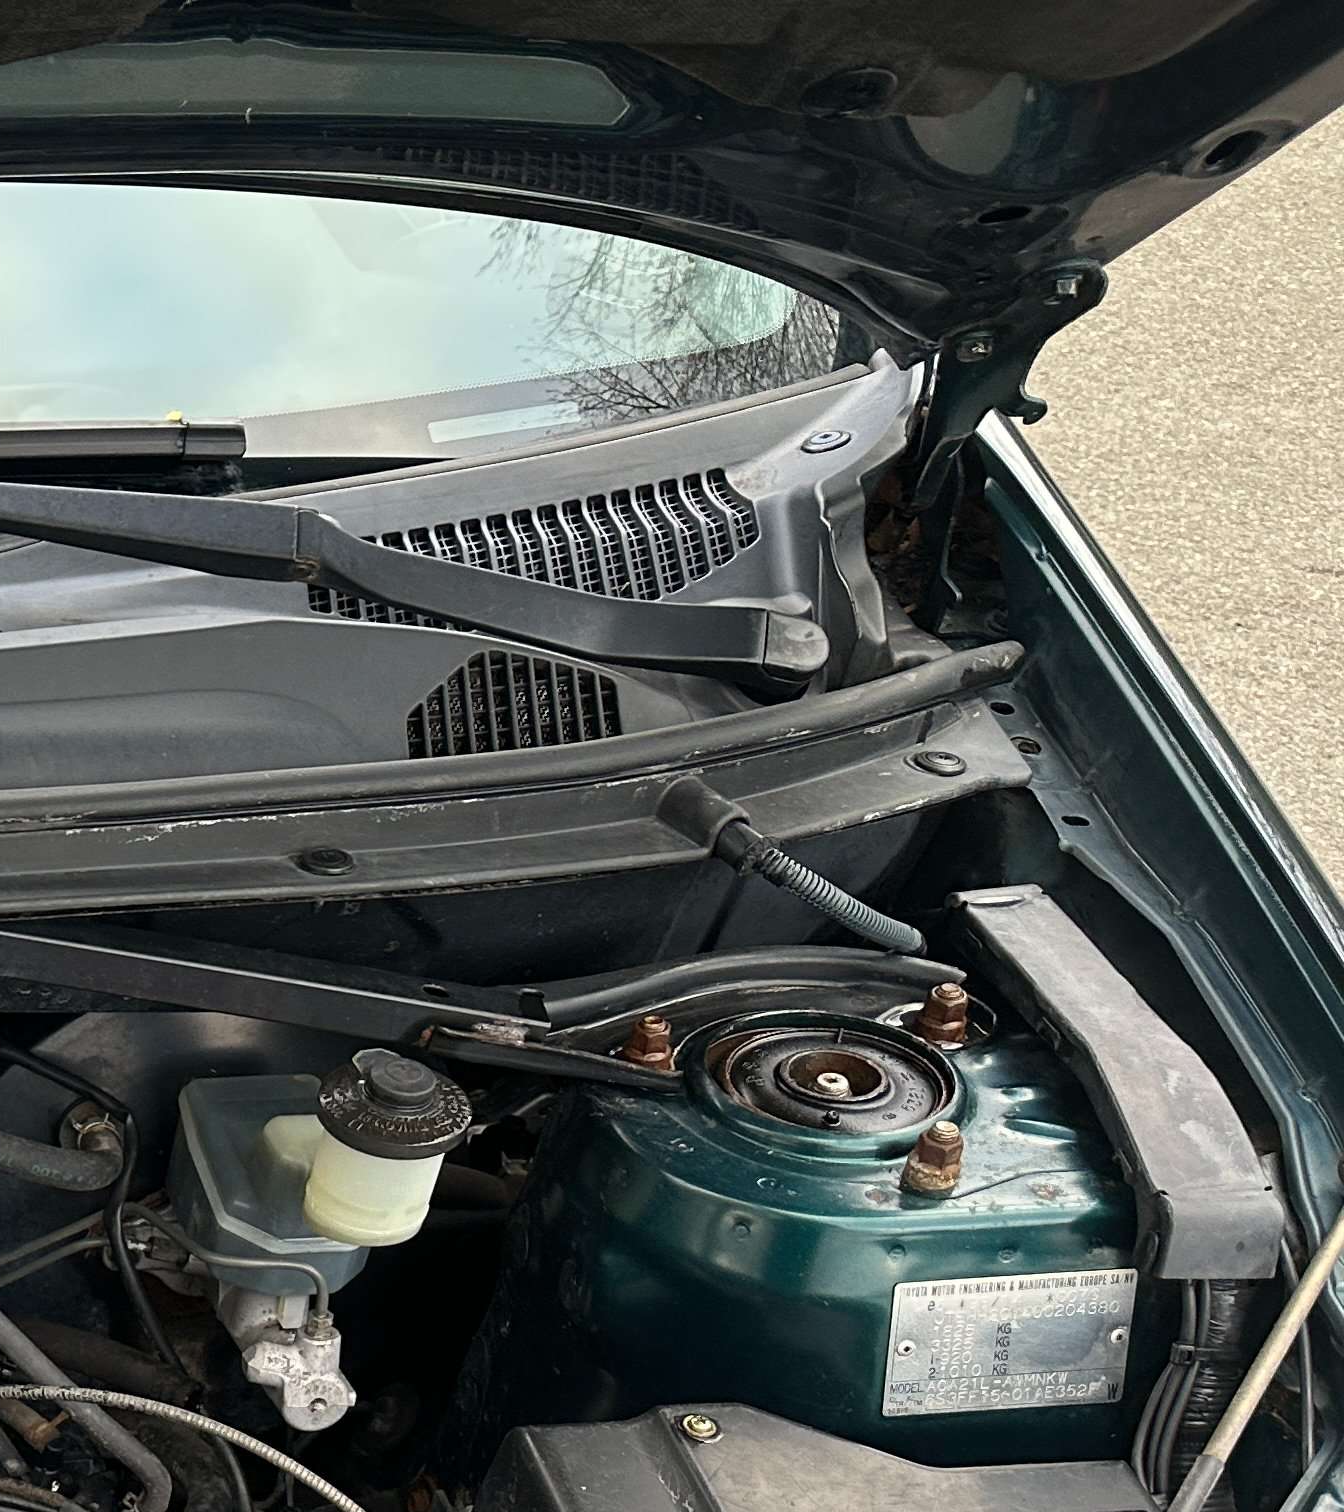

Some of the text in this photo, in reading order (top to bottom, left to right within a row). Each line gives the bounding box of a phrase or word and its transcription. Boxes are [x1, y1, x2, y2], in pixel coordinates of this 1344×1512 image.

[903, 1286, 928, 1298] TOYOTA
[932, 1284, 956, 1296] MOTOR
[959, 1282, 1006, 1295] ENGINEERING
[1018, 1277, 1077, 1291] MANUFACTURING
[1080, 1274, 1107, 1287] EUROPE
[1110, 1273, 1134, 1286] SA/NV
[996, 1323, 1012, 1335] KG
[995, 1336, 1010, 1348] KG
[993, 1350, 1009, 1362] KG
[992, 1364, 1008, 1376] KG
[889, 1382, 923, 1394] MODEL
